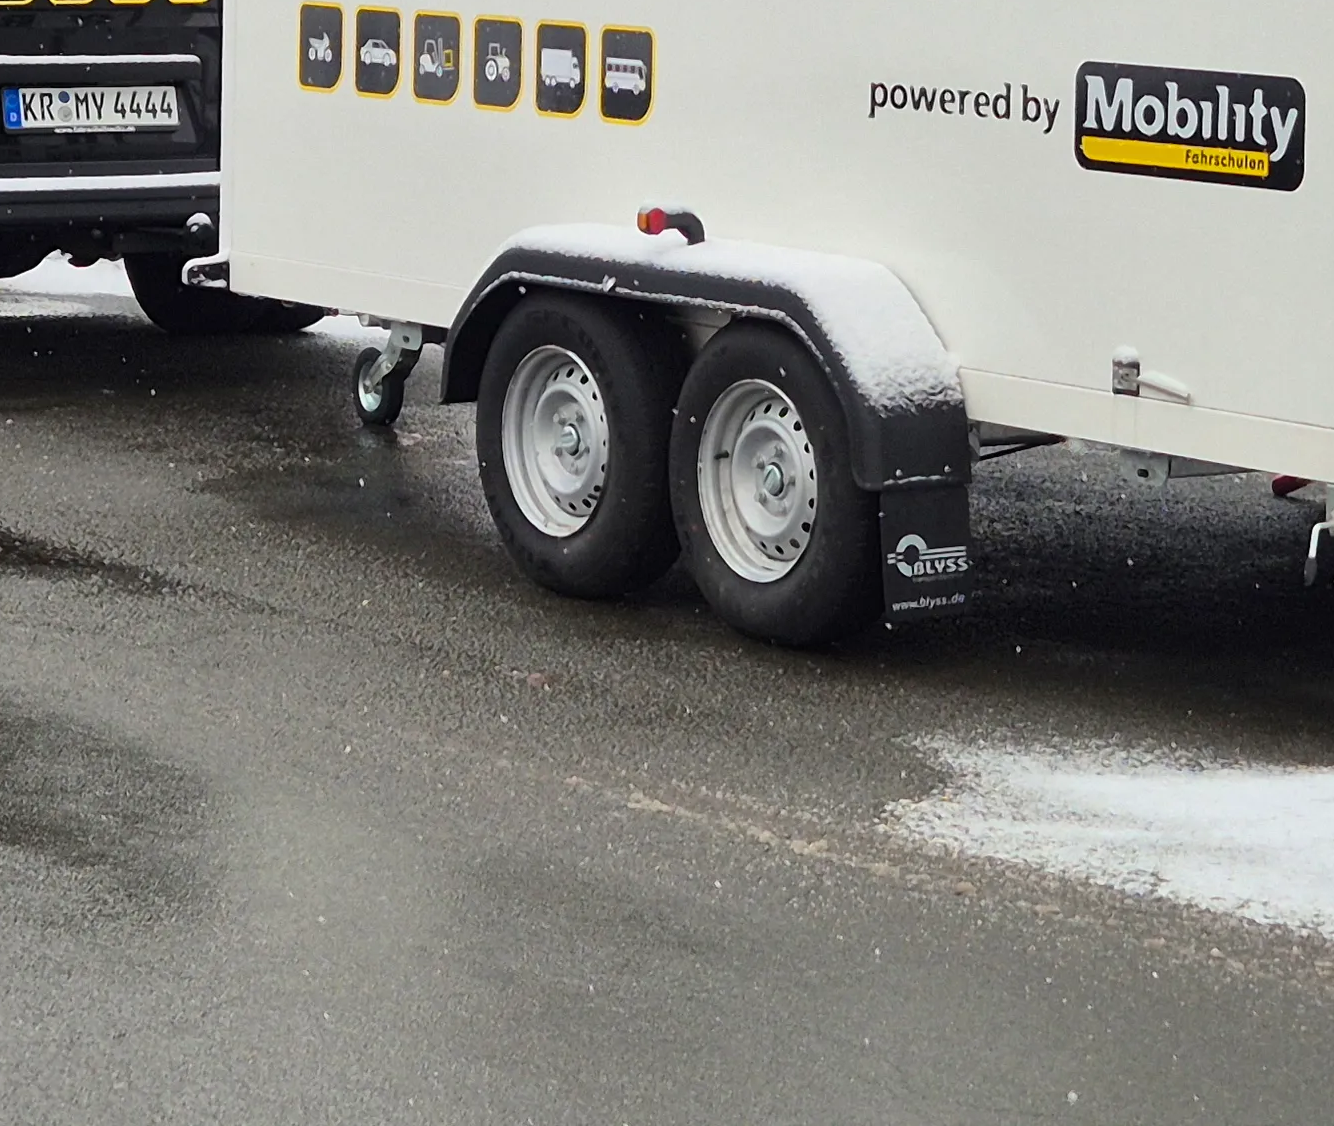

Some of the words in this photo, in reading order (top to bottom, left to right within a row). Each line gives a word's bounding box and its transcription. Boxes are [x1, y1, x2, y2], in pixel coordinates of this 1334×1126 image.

[21, 92, 55, 122] KR
[74, 91, 105, 121] MY
[113, 90, 173, 120] 4444
[868, 81, 1011, 120] powered
[1021, 84, 1060, 134] by
[1082, 74, 1298, 163] Mobility
[913, 557, 968, 575] BLYSS
